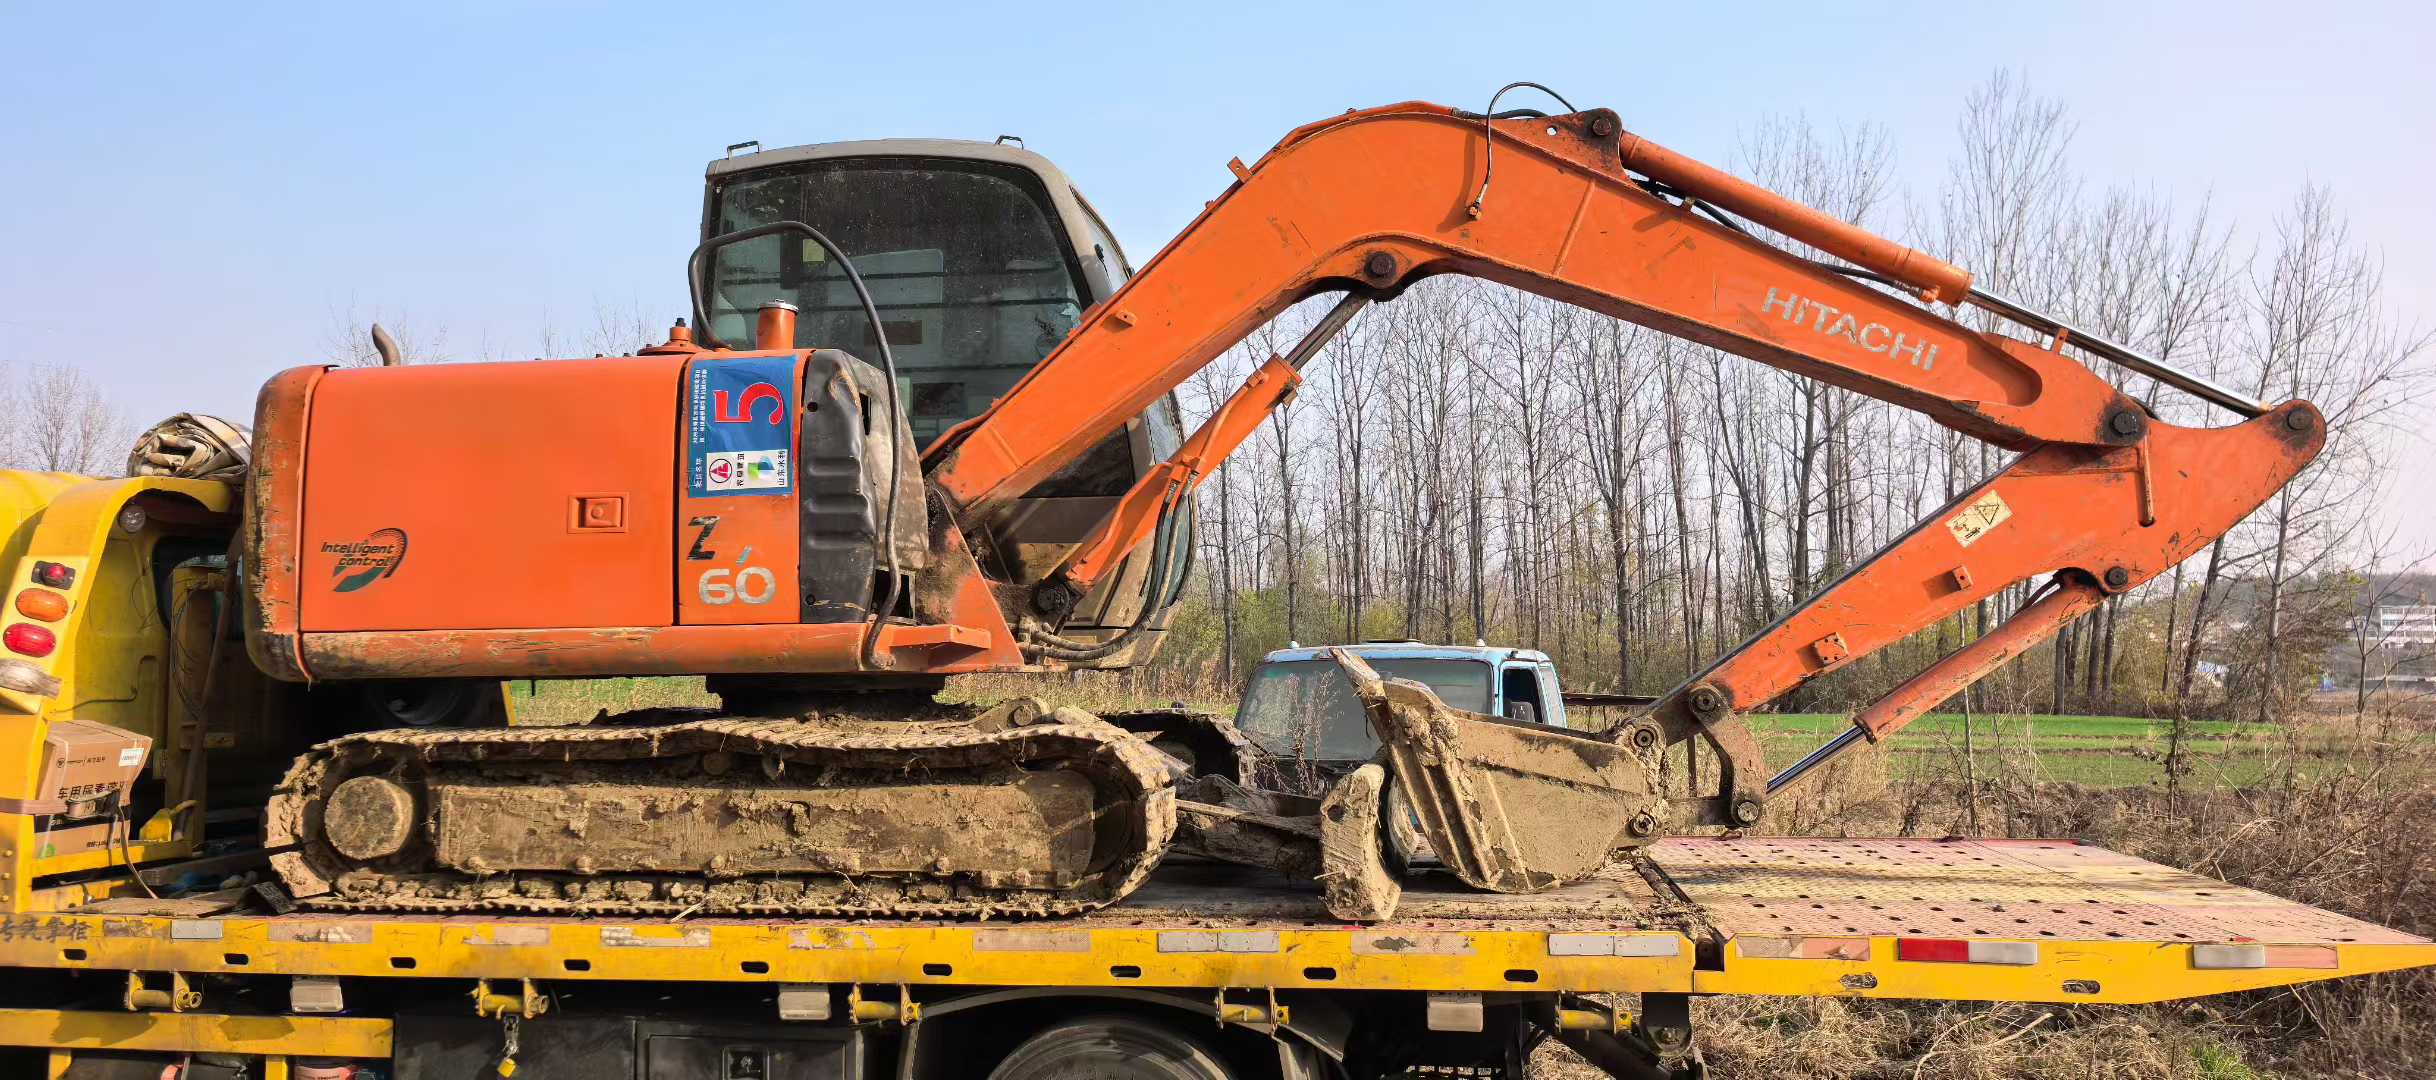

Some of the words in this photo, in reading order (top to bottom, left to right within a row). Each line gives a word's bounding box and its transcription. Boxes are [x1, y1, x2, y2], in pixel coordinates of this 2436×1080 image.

[1762, 287, 1939, 371] HITACHI
[713, 382, 784, 425] 5
[320, 539, 395, 557] Intelligent
[338, 555, 390, 567] control
[699, 566, 776, 605] 60
